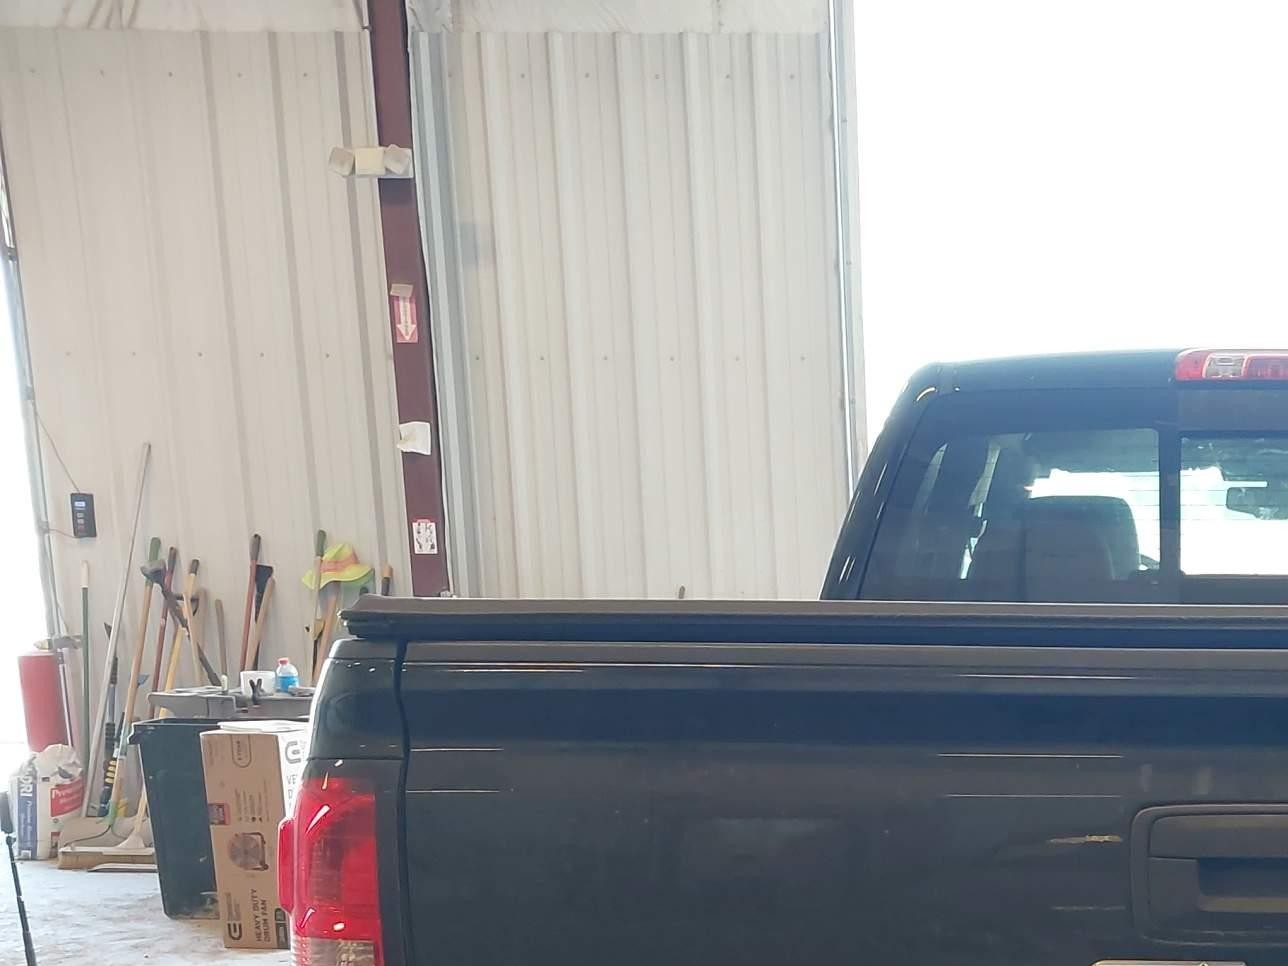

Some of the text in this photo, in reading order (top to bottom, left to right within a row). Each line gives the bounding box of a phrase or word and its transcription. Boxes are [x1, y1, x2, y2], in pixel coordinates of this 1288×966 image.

[250, 888, 262, 941] HEAVY DUTY
[260, 899, 270, 942] DRUM FAN
